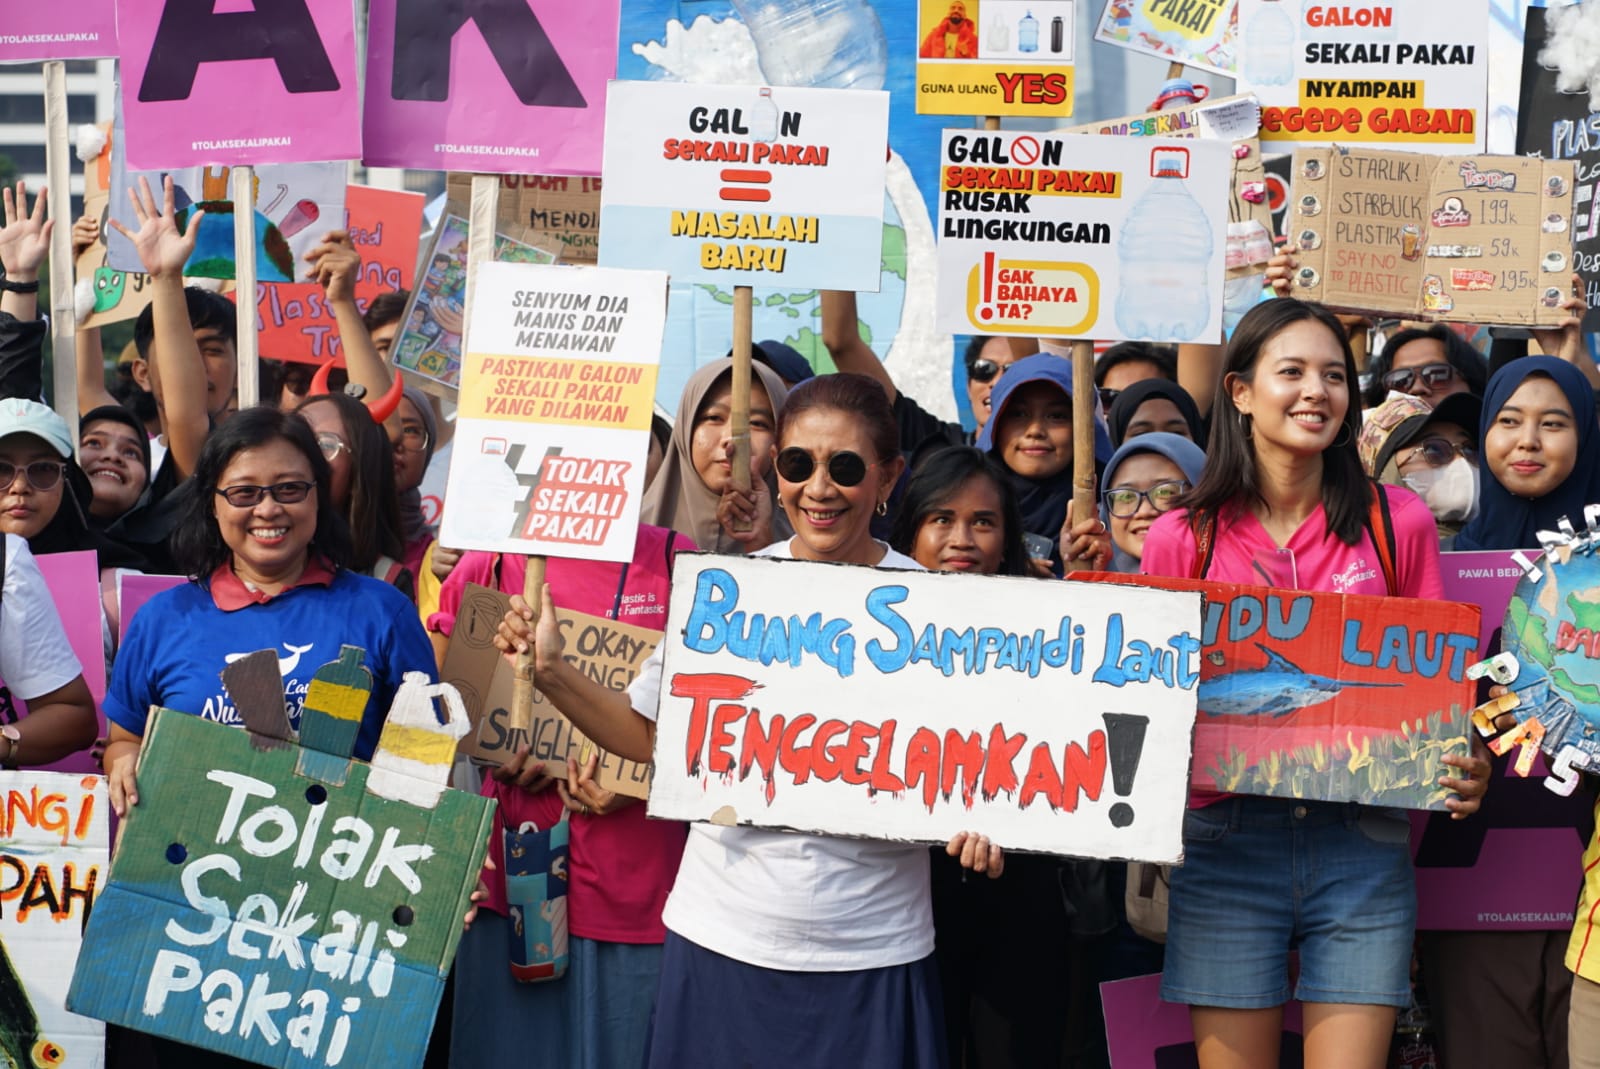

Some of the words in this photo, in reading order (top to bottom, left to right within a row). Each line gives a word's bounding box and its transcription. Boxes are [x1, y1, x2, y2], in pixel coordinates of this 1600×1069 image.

[1306, 7, 1392, 27] GALON
[1305, 43, 1390, 64] SEKALI
[1397, 44, 1475, 65] PAKAI
[921, 83, 954, 94] GUNA
[958, 84, 997, 95] ULANG
[996, 73, 1067, 104] YES
[1129, 110, 1199, 137] SEKALI
[1258, 106, 1362, 134] EGEDE
[192, 136, 291, 150] #TOLAKSEKALIPAKAI
[434, 143, 539, 157] #TOLAKSEKALIPAKAI
[753, 142, 829, 166] PAKAI
[1038, 168, 1116, 194] PAKAI
[530, 208, 600, 228] MENDI
[1338, 192, 1422, 220] STARBUCK
[345, 210, 383, 246] eed
[670, 210, 819, 243] MASALAH
[1336, 221, 1401, 245] PLASTIK
[1336, 249, 1367, 269] SAY
[1371, 253, 1397, 270] NO
[998, 269, 1034, 285] GAK
[1348, 271, 1409, 294] PLASTIC
[512, 290, 591, 311] SENYUM
[596, 295, 629, 314] DIA
[997, 285, 1077, 303] BAHAYA
[513, 311, 577, 331] MANIS
[581, 315, 623, 333] DAN
[996, 303, 1033, 321] TA?
[515, 331, 616, 353] MENAWAN
[480, 358, 575, 381] PASTIKAN
[579, 364, 643, 385] GALON
[494, 378, 559, 399] SEKALI
[563, 382, 623, 403] PAKAI
[484, 397, 534, 417] YANG
[540, 401, 629, 423] DILAWAN
[545, 459, 628, 487] TOLAK
[535, 488, 622, 517] SEKALI
[527, 514, 607, 541] PAKAI
[1458, 569, 1494, 579] PAWAI
[614, 593, 646, 604] lastic
[648, 592, 656, 602] is
[605, 608, 621, 617] nt
[624, 604, 665, 616] Fantastic
[684, 568, 856, 678] BUANG
[577, 625, 646, 664] OKAY
[1342, 620, 1479, 683] LAUT
